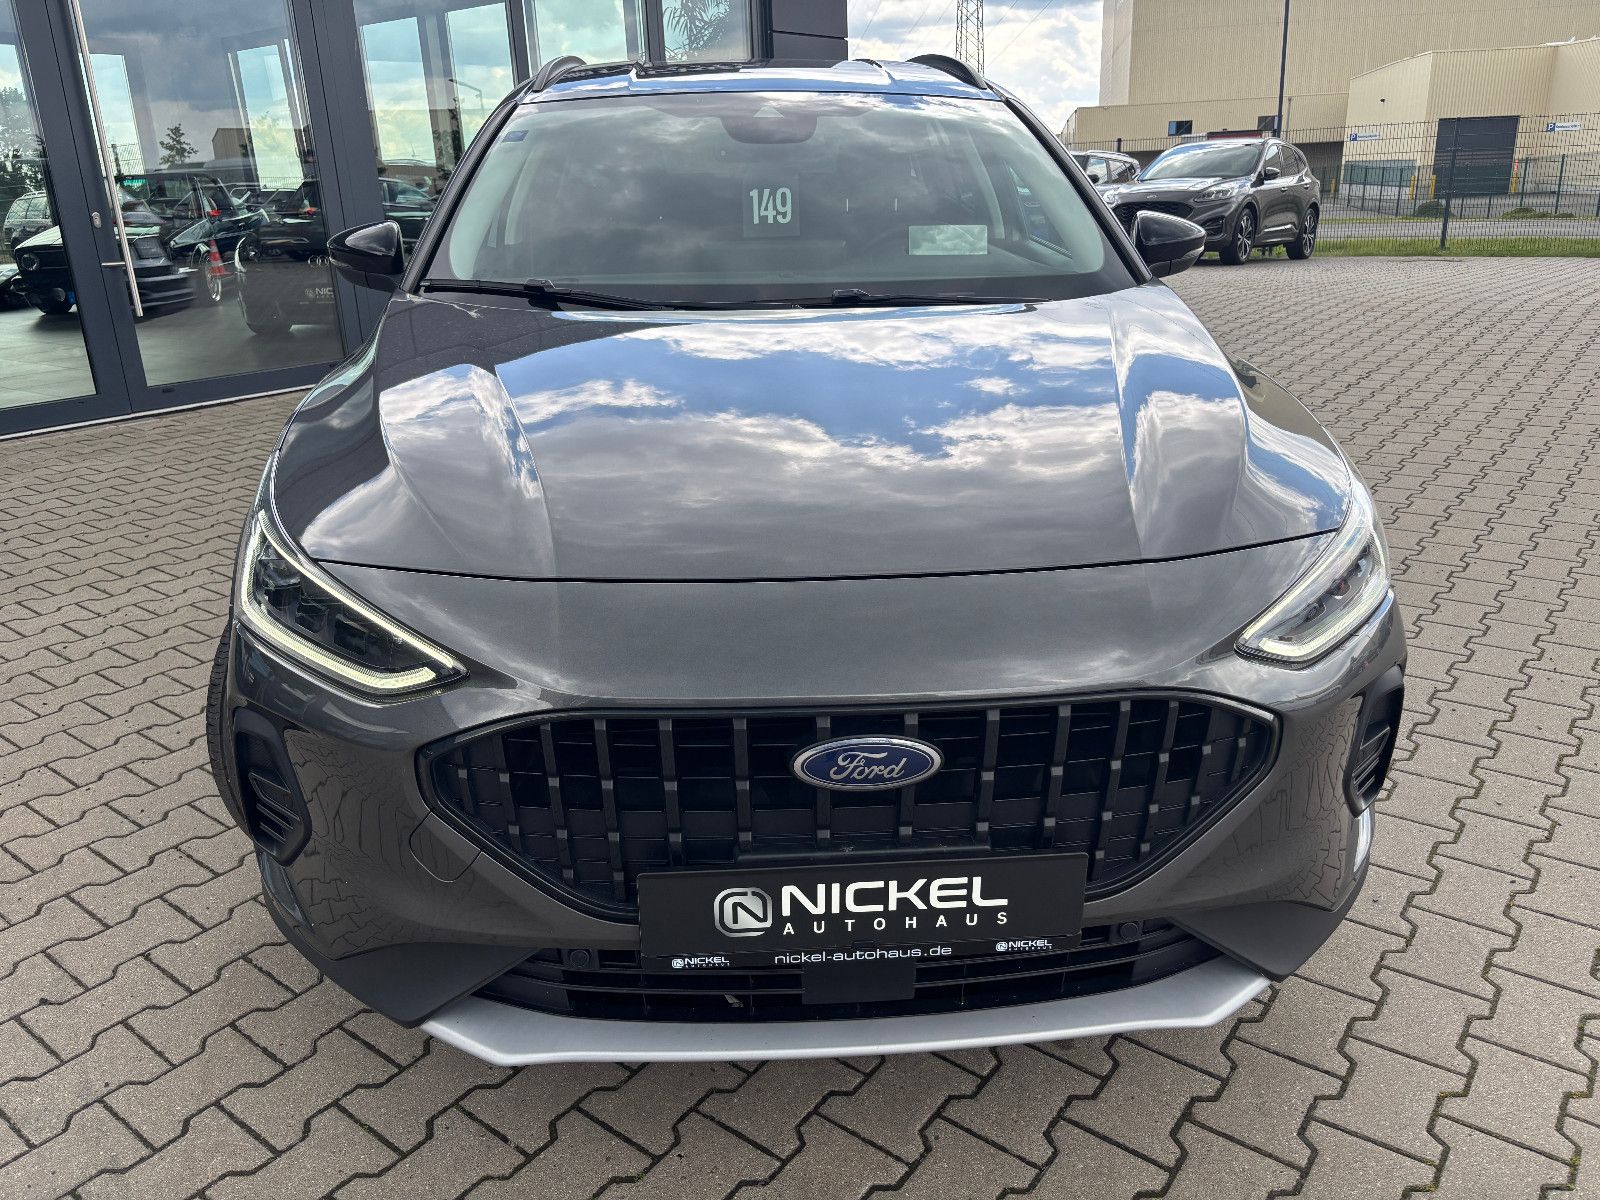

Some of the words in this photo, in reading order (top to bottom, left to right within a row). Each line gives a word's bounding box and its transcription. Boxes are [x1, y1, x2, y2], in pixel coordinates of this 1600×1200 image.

[749, 187, 792, 224] 149
[829, 751, 907, 780] Ford
[781, 876, 1009, 917] NICKEL
[782, 911, 1008, 936] AUTOHAUS
[774, 945, 953, 965] nickel-autohaus.de
[1008, 939, 1053, 948] NICKEL
[684, 956, 730, 965] NICKEL
